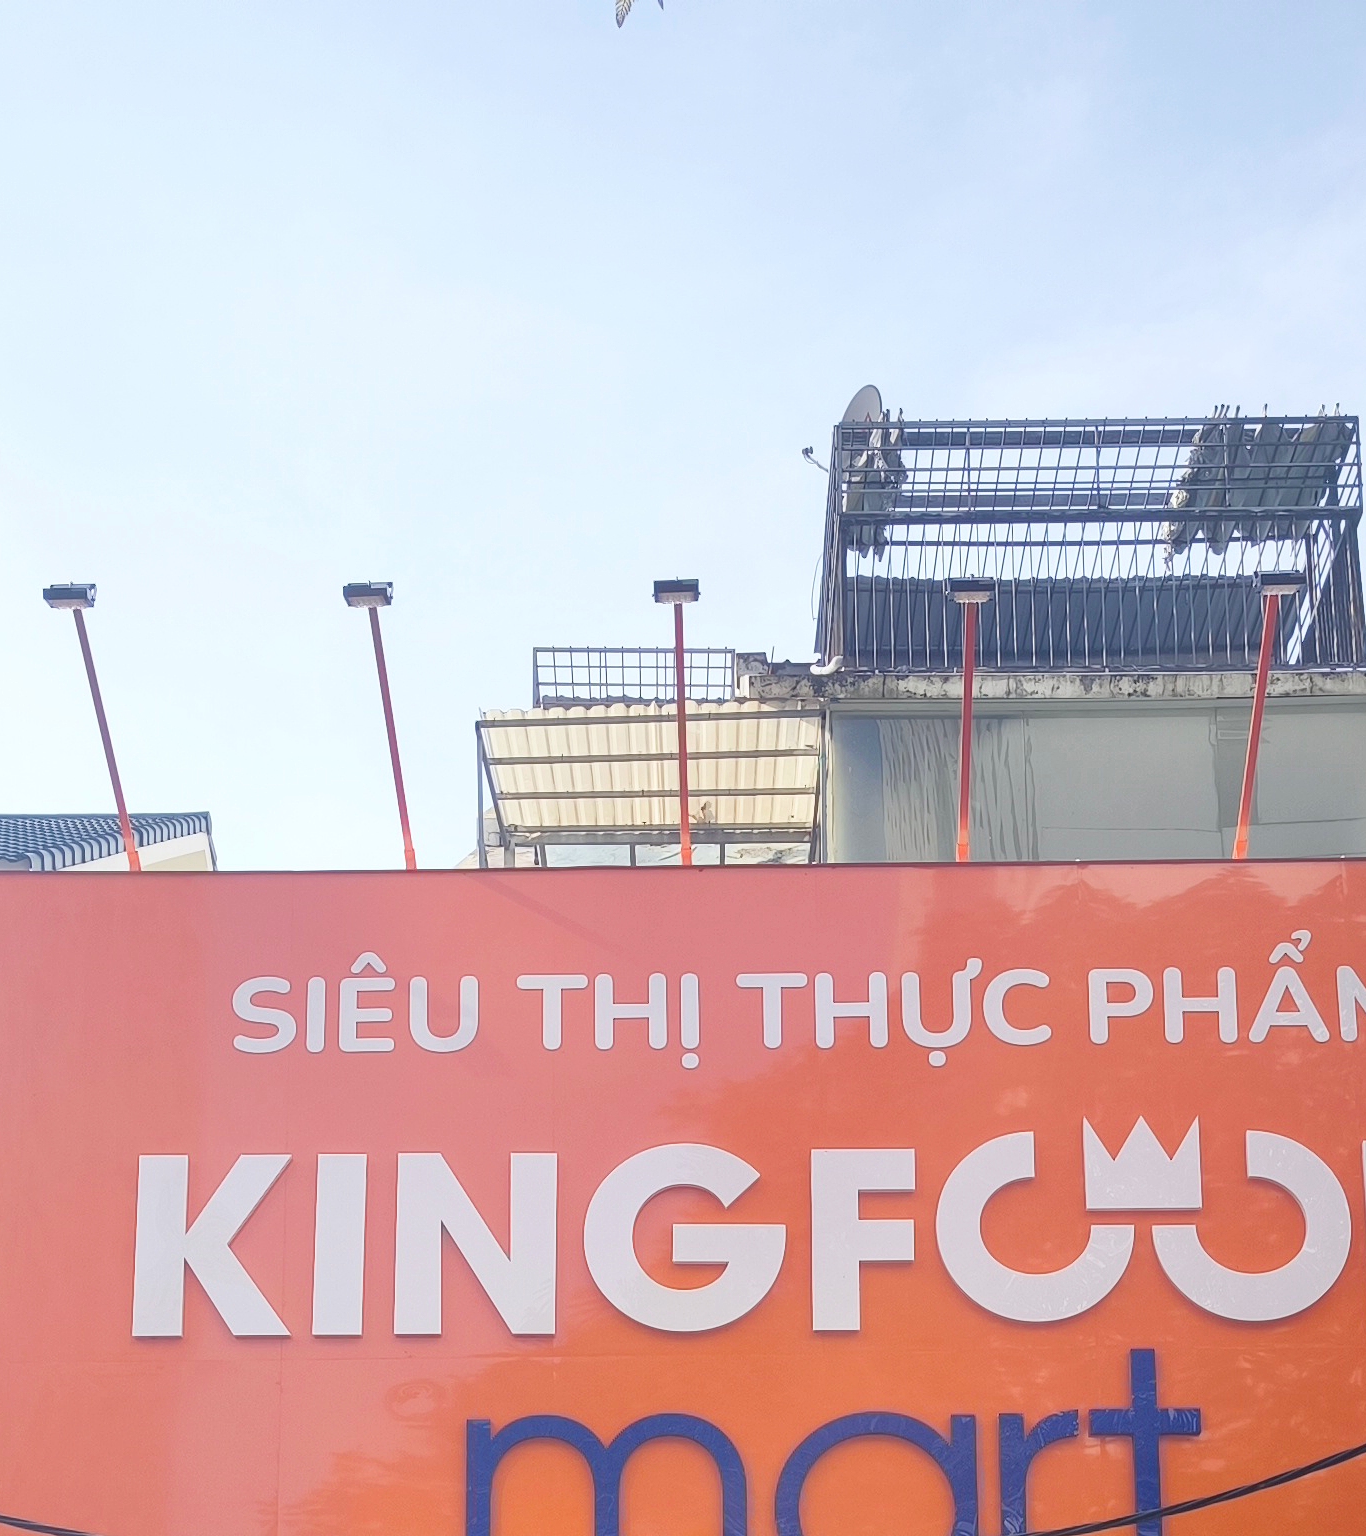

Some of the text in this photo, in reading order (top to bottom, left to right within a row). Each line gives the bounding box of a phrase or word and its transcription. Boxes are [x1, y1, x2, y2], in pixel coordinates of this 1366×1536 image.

[232, 954, 479, 1055] SIÊU
[519, 969, 702, 1069] THỊ
[738, 958, 1052, 1069] THỰC
